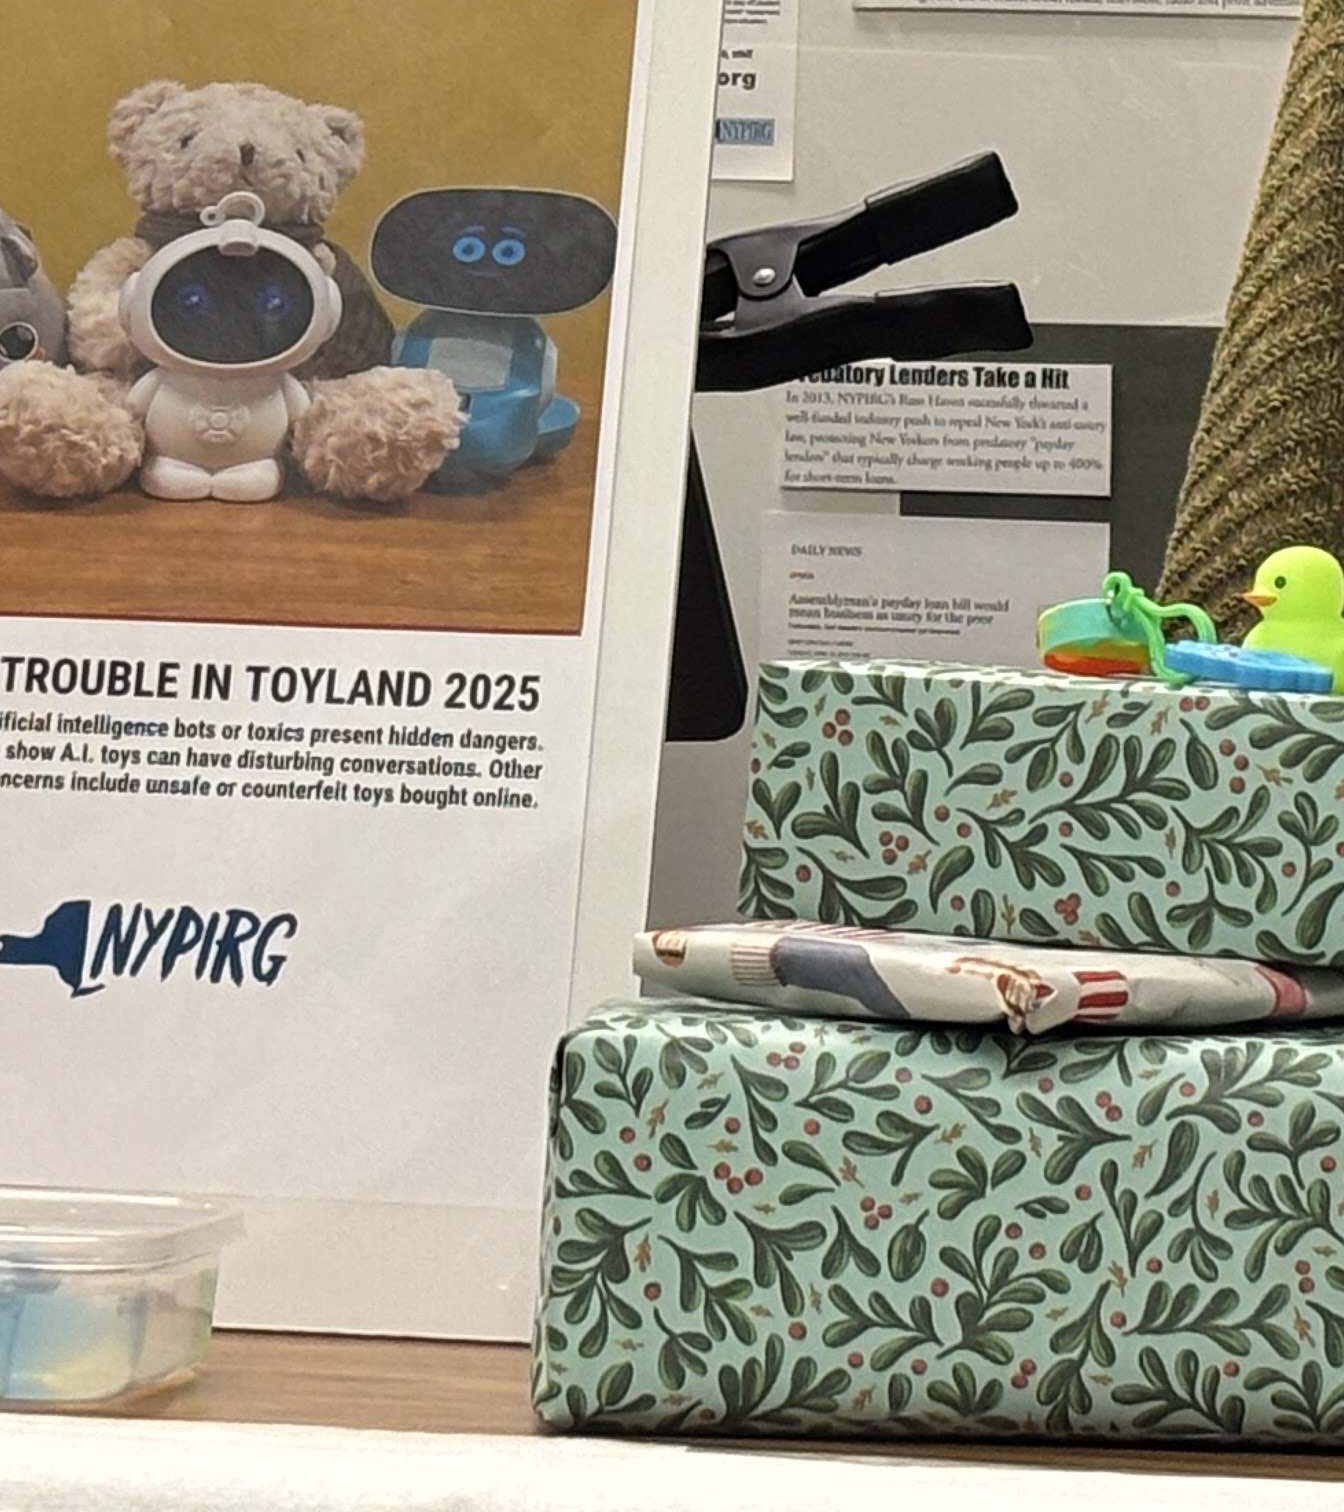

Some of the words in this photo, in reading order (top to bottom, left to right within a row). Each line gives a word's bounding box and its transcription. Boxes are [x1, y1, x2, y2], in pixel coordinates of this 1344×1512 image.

[889, 365, 969, 387] Lenders
[973, 367, 1020, 388] Take
[1025, 370, 1036, 388] a
[1042, 368, 1069, 389] Hit
[791, 544, 826, 556] DAILY
[1, 656, 182, 701] TROUBLE
[190, 662, 233, 702] IN
[246, 665, 433, 709] TOYLAND
[444, 673, 541, 712] 2025
[57, 714, 169, 741] intelligence
[174, 717, 216, 740] bots
[221, 722, 242, 741] or
[246, 719, 305, 745] toxics
[309, 723, 383, 751] present
[388, 725, 454, 749] hidden
[459, 729, 545, 755] dangers.
[5, 740, 54, 763] show
[60, 742, 94, 766] A.I.
[101, 744, 141, 768] toys
[147, 747, 182, 768] can
[185, 746, 231, 769] have
[237, 748, 335, 777] disturbing
[339, 754, 482, 778] conversations.
[488, 759, 544, 782] Other
[71, 770, 140, 796] include
[146, 775, 212, 798] unsafe
[216, 779, 236, 799] or
[241, 778, 348, 804] counterfeit
[353, 783, 396, 807] toys
[399, 784, 467, 811] bought
[472, 788, 539, 811] online.
[89, 902, 298, 986] NYPIRG
